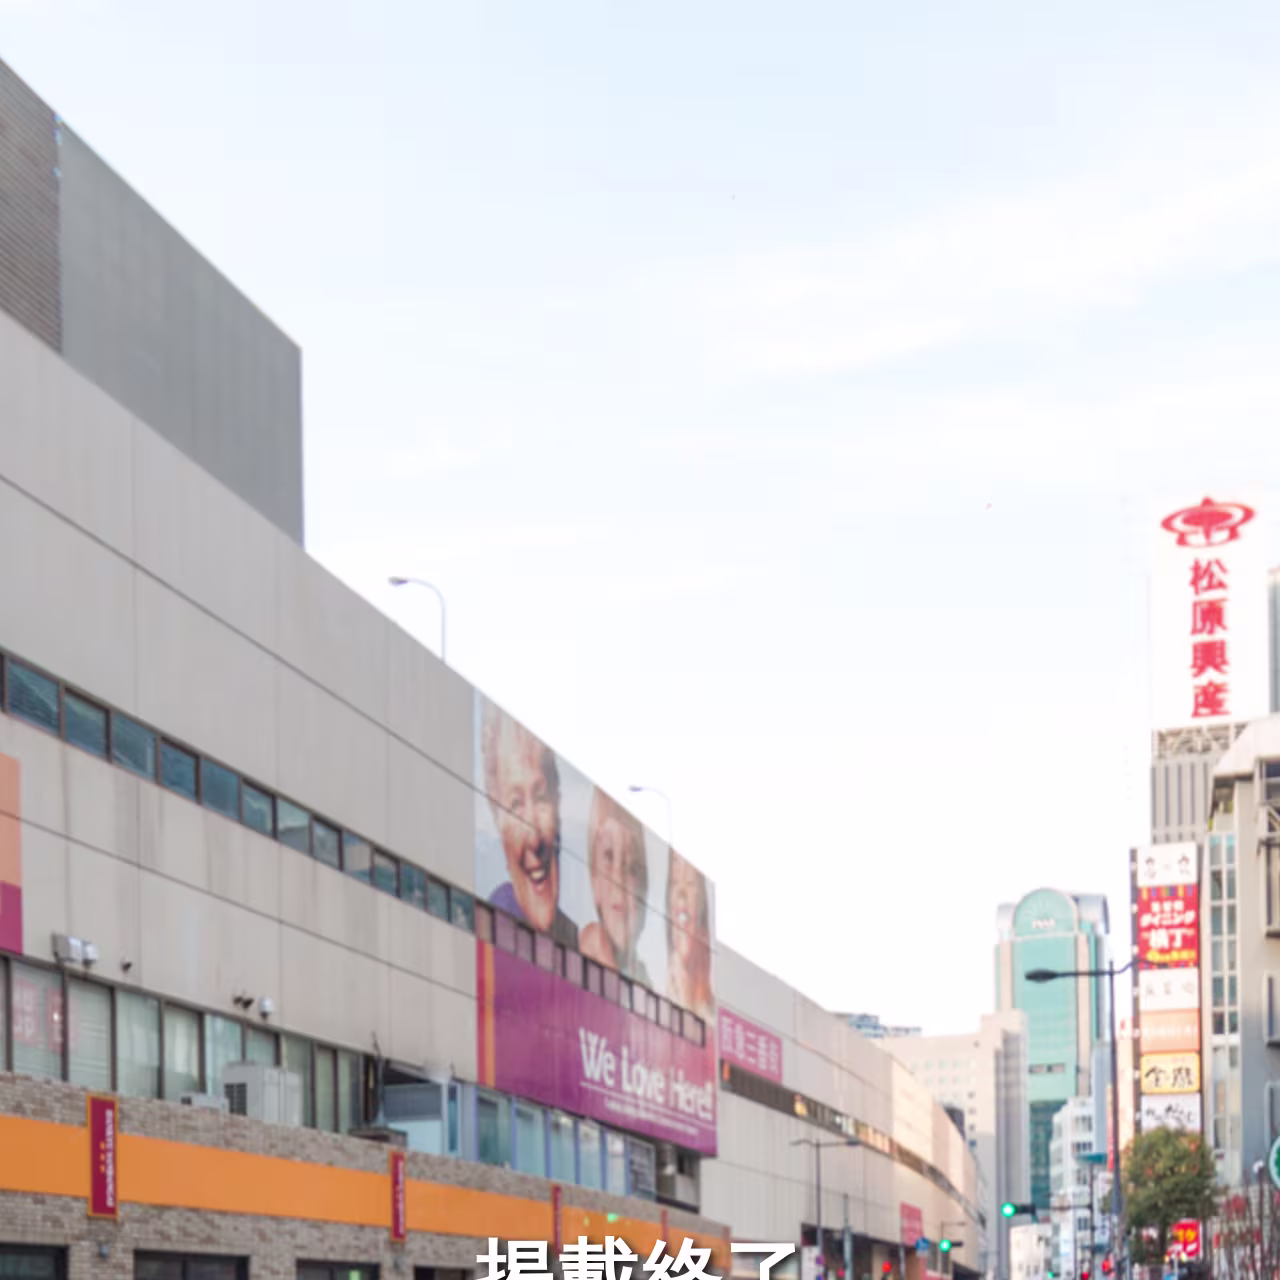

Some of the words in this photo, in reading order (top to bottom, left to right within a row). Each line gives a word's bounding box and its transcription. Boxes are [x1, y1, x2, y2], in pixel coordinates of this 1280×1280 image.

[1190, 557, 1231, 719] 松原興産
[579, 1027, 616, 1087] We
[622, 1046, 665, 1103] Love
